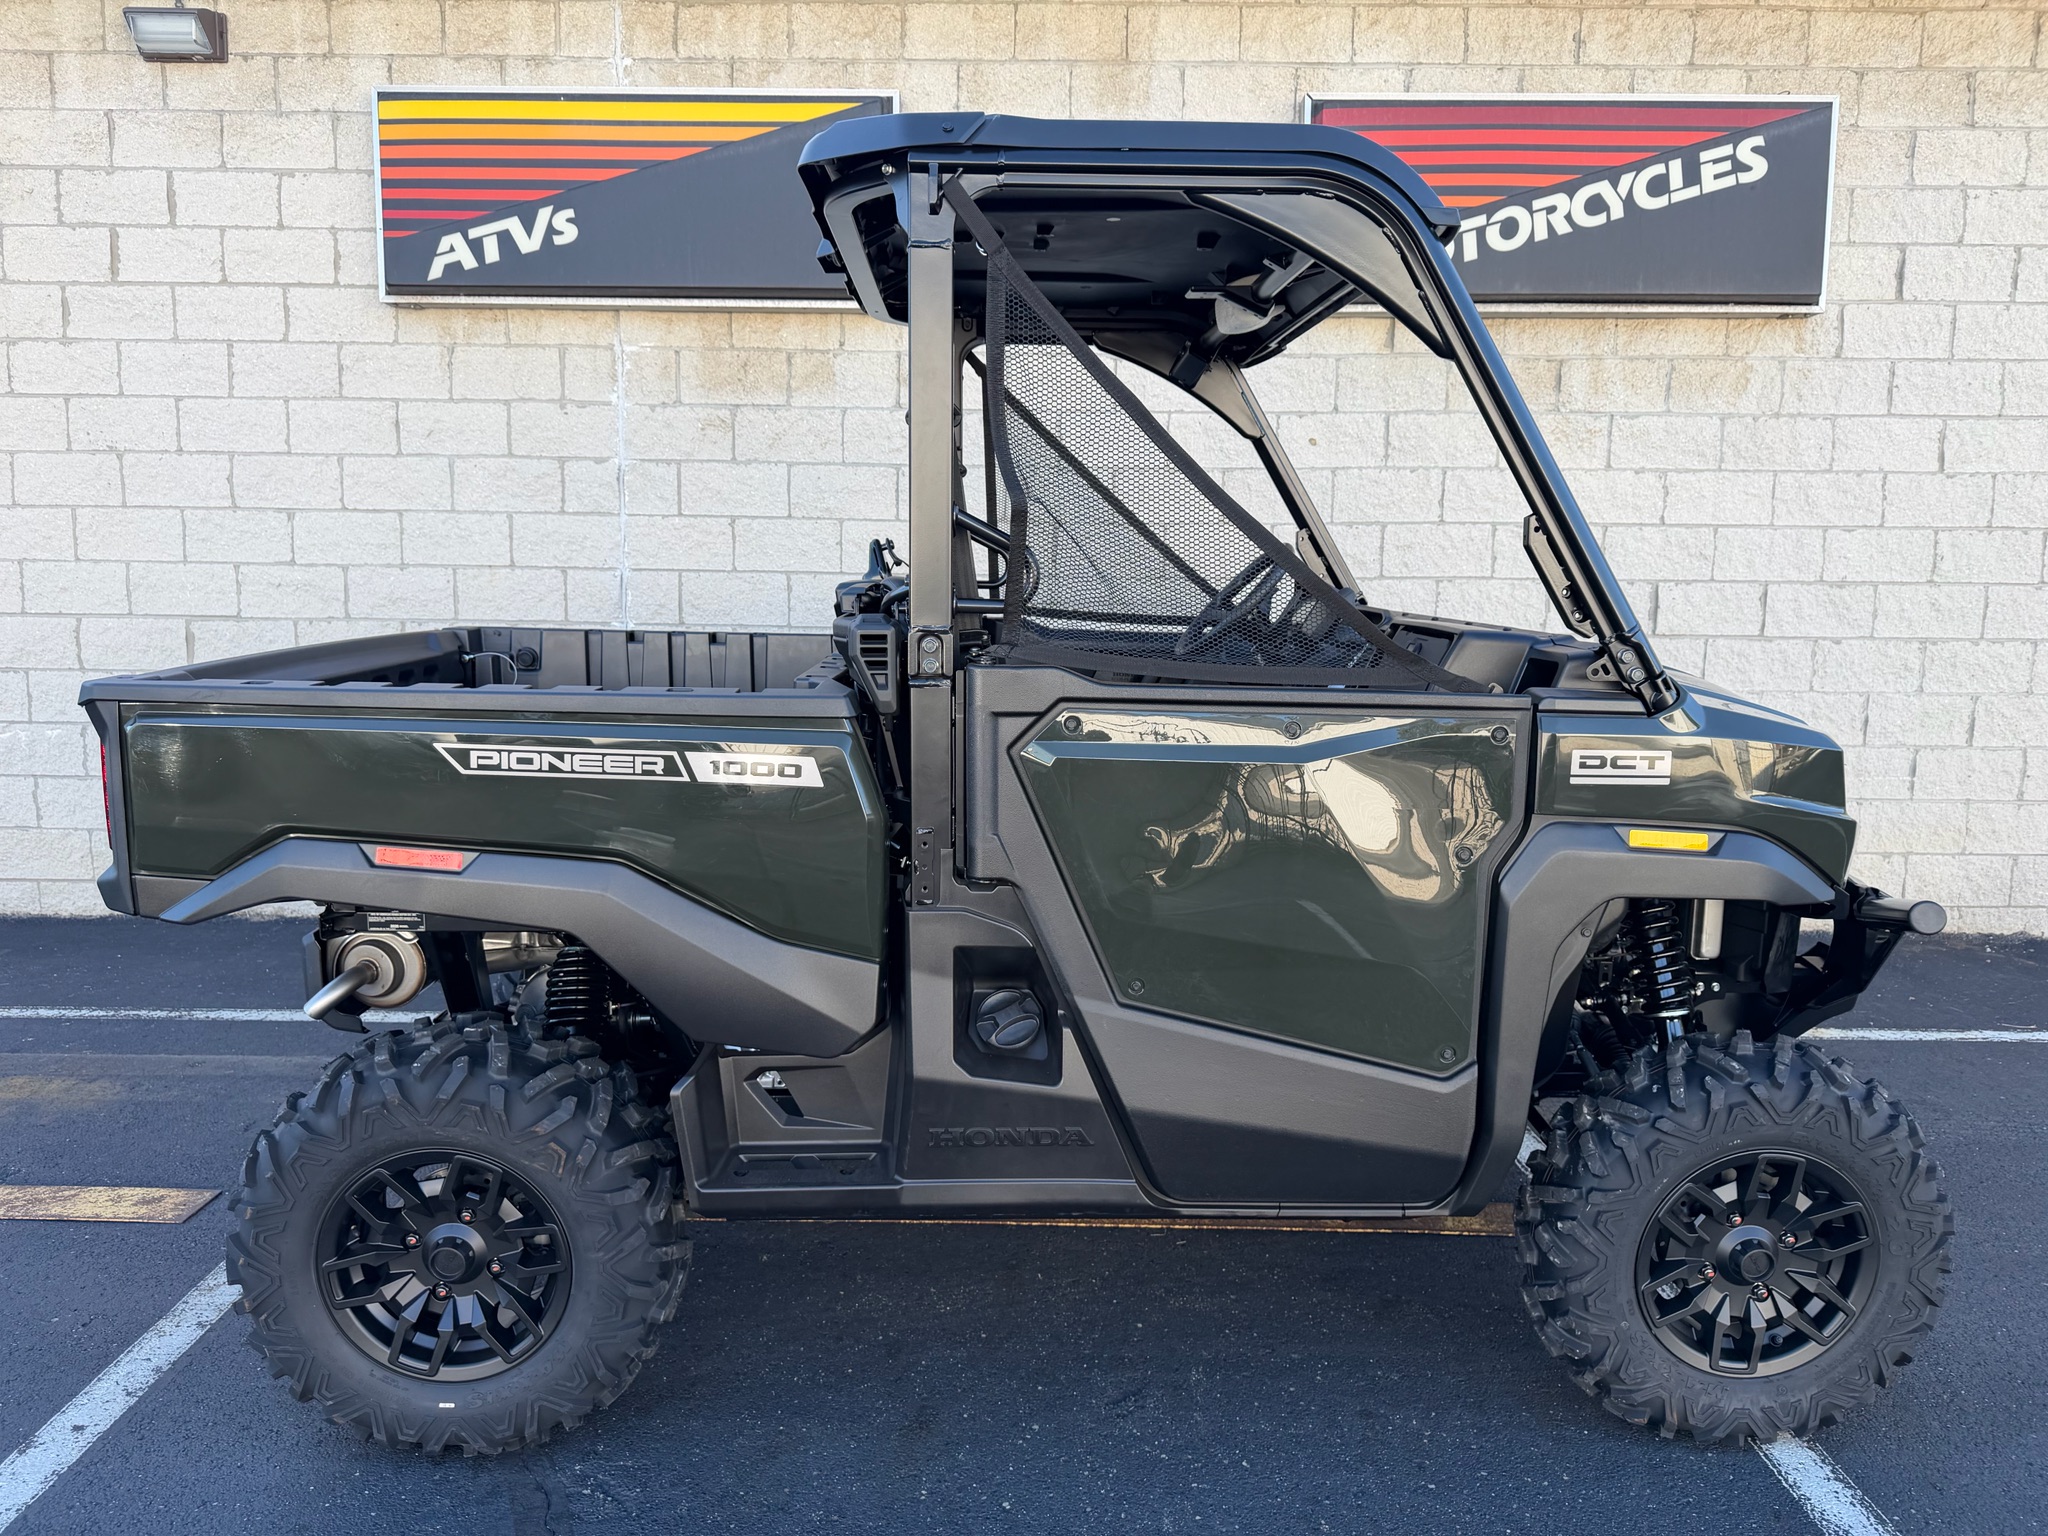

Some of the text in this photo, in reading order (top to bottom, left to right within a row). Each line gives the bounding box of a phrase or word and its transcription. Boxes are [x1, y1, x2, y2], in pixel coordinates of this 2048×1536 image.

[1445, 135, 1769, 262] TORCYCLES
[427, 204, 579, 281] ATVs
[470, 750, 802, 778] PIONEER 1000
[1578, 755, 1665, 770] DCT
[928, 1126, 1096, 1147] HONDA
